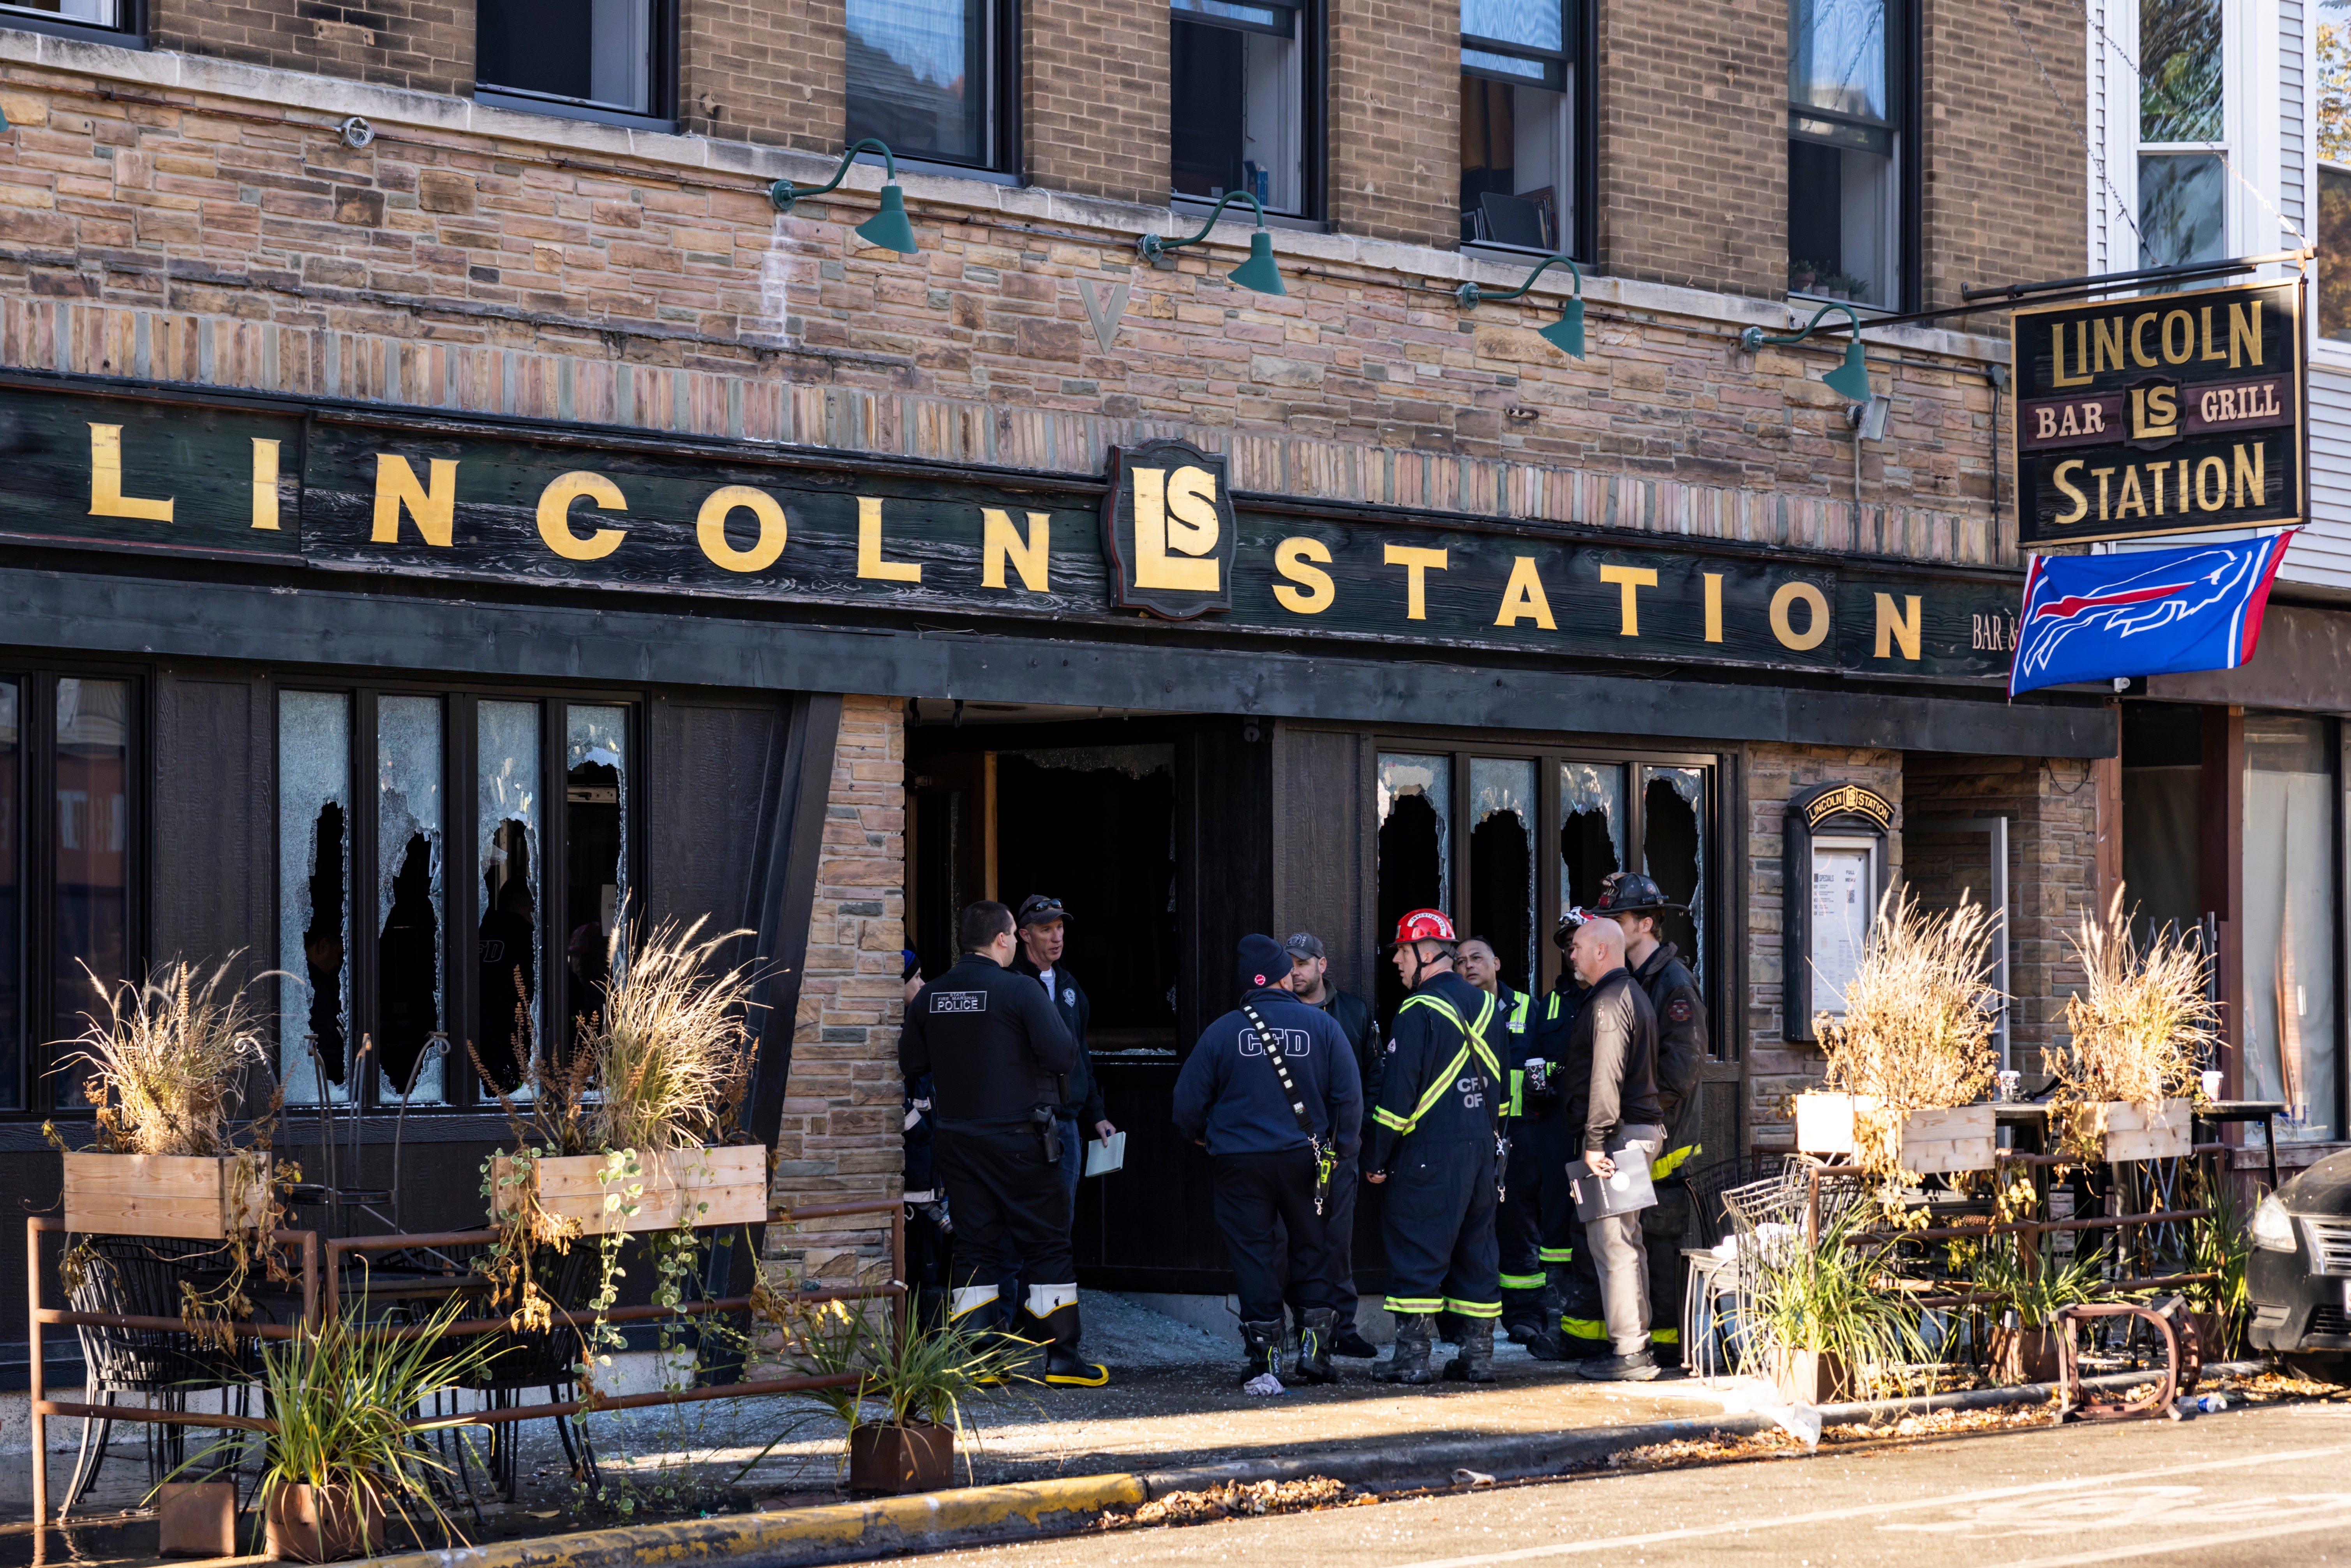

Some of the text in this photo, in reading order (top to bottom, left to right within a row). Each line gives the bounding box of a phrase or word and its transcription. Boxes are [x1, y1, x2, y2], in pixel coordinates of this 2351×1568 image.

[2051, 300, 2263, 387] LINCOLN
[2035, 384, 2280, 439] BAR LS GRILL
[2054, 442, 2266, 524] STATION
[86, 422, 1051, 593] LINCOLN
[1272, 536, 1922, 660] STATION
[1972, 613, 2019, 651] BAR &
[1808, 794, 1842, 820] LINCOLN
[1858, 794, 1889, 820] STATION
[1411, 913, 1445, 929] INVESTIGATOR
[937, 1000, 978, 1011] POLICE
